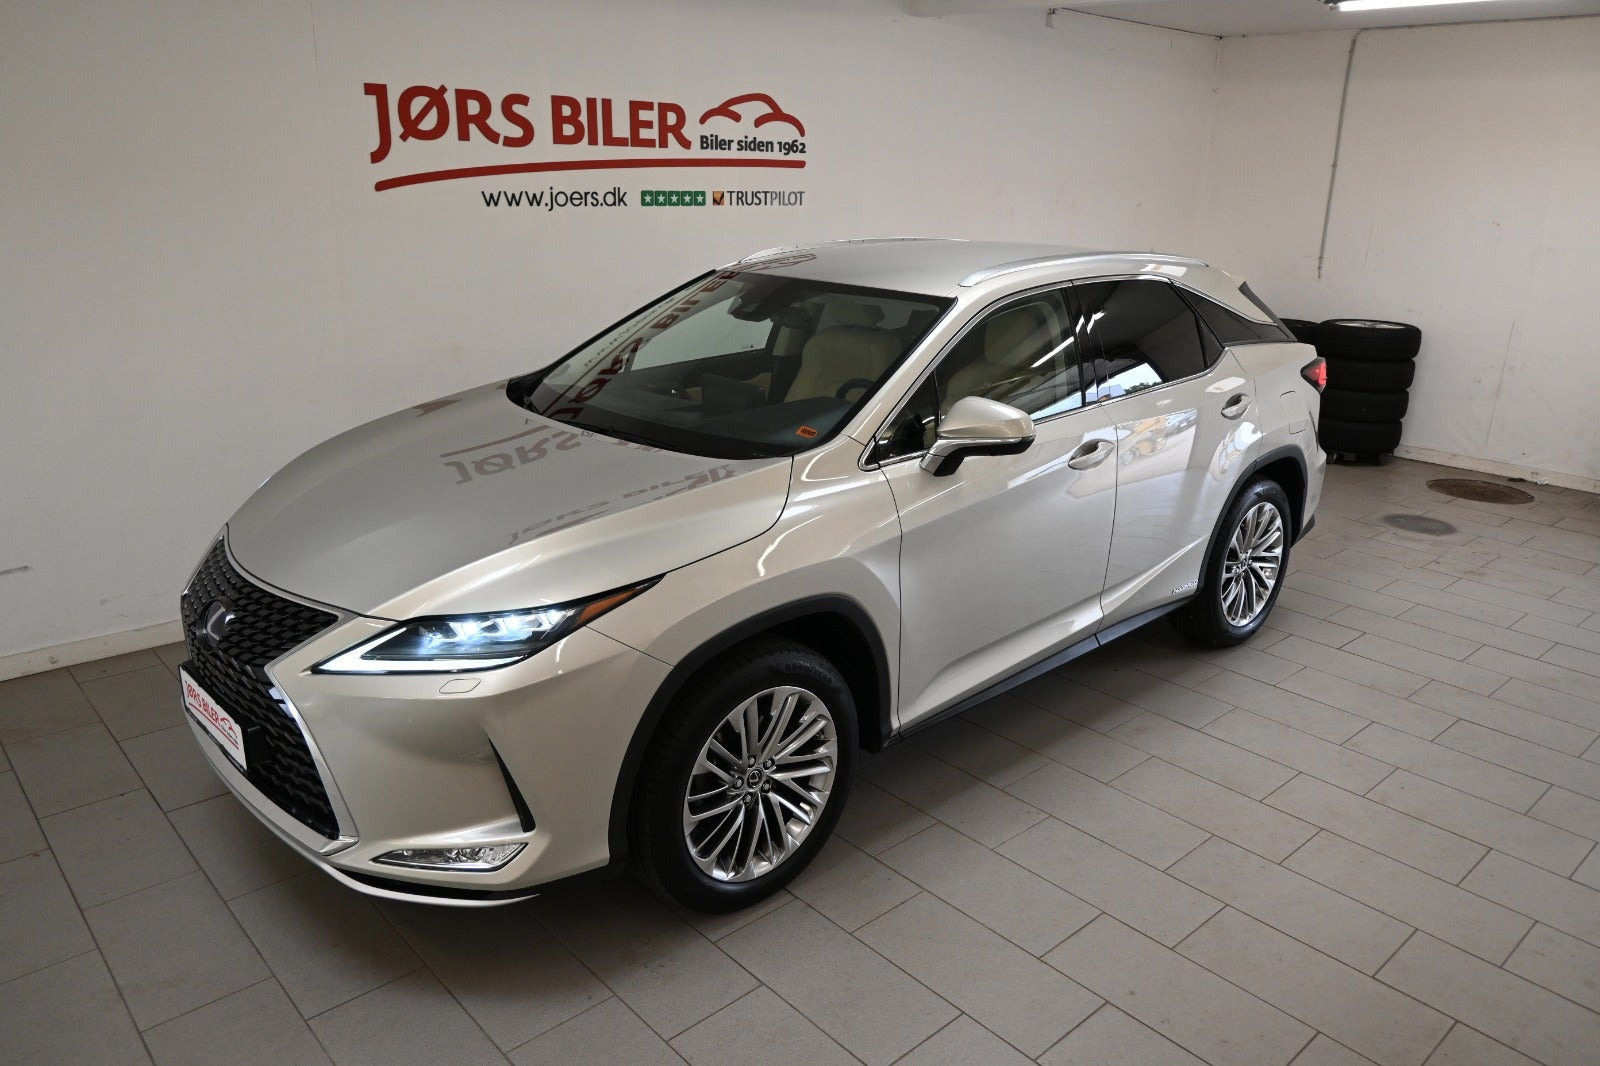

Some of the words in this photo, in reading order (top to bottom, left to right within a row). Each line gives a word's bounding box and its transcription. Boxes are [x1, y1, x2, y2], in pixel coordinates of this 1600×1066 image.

[363, 82, 535, 164] JØRS
[550, 95, 692, 151] BILER
[700, 133, 734, 151] Biler
[736, 135, 774, 153] siden
[777, 139, 807, 156] 1962
[481, 186, 628, 212] www.joers.dk
[726, 190, 806, 207] TRUSTPILOT
